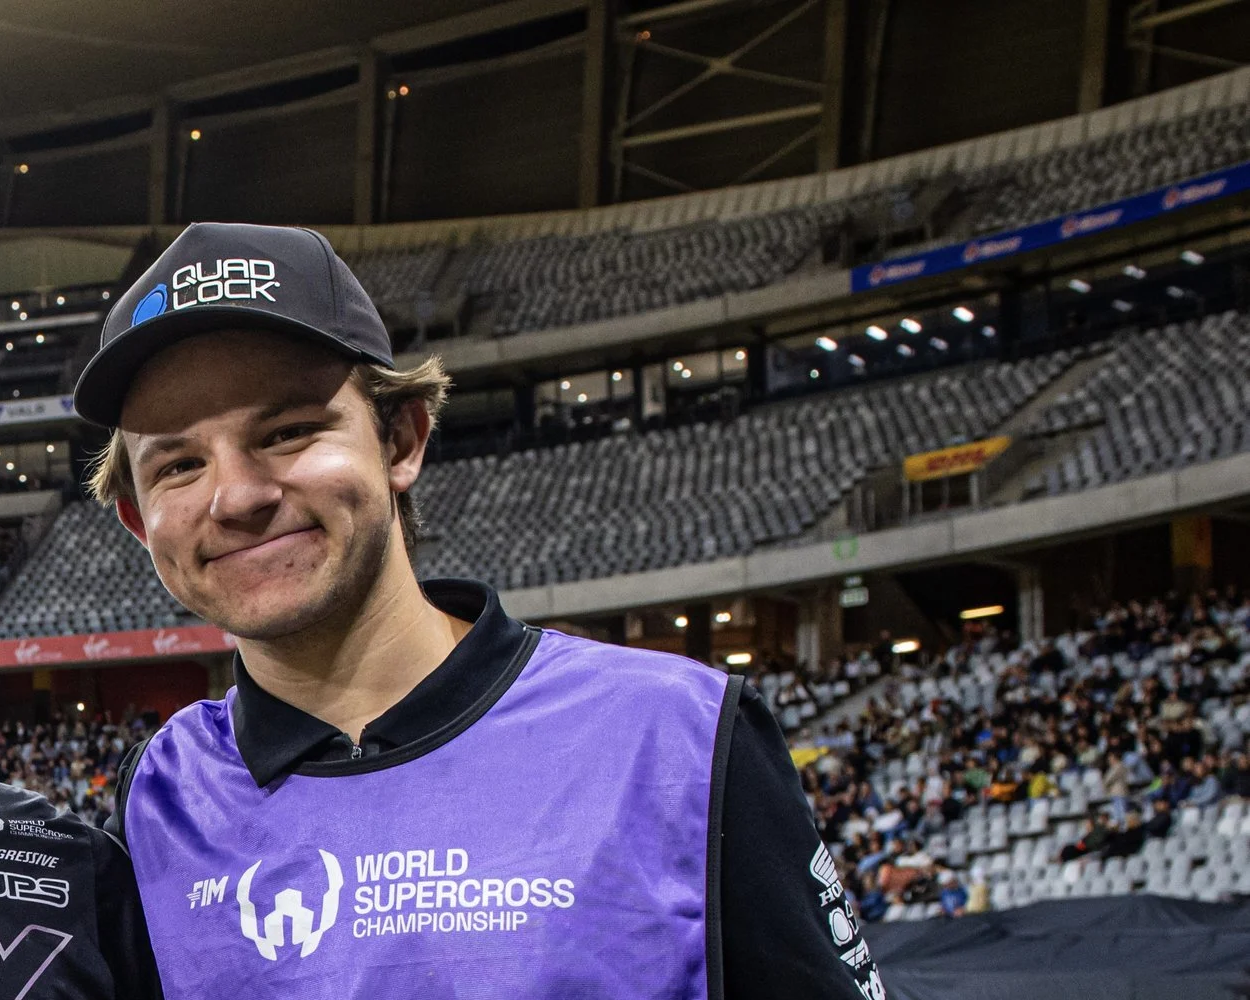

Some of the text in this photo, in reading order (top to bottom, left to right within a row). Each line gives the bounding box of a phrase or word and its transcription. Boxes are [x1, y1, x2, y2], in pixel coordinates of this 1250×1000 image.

[172, 258, 275, 290] QUAD
[172, 279, 280, 310] LOCK
[355, 848, 469, 882] WORLD
[186, 875, 229, 909] FIM
[353, 877, 575, 915] SUPERCROSS
[353, 910, 528, 938] CHAMPIONSHIP
